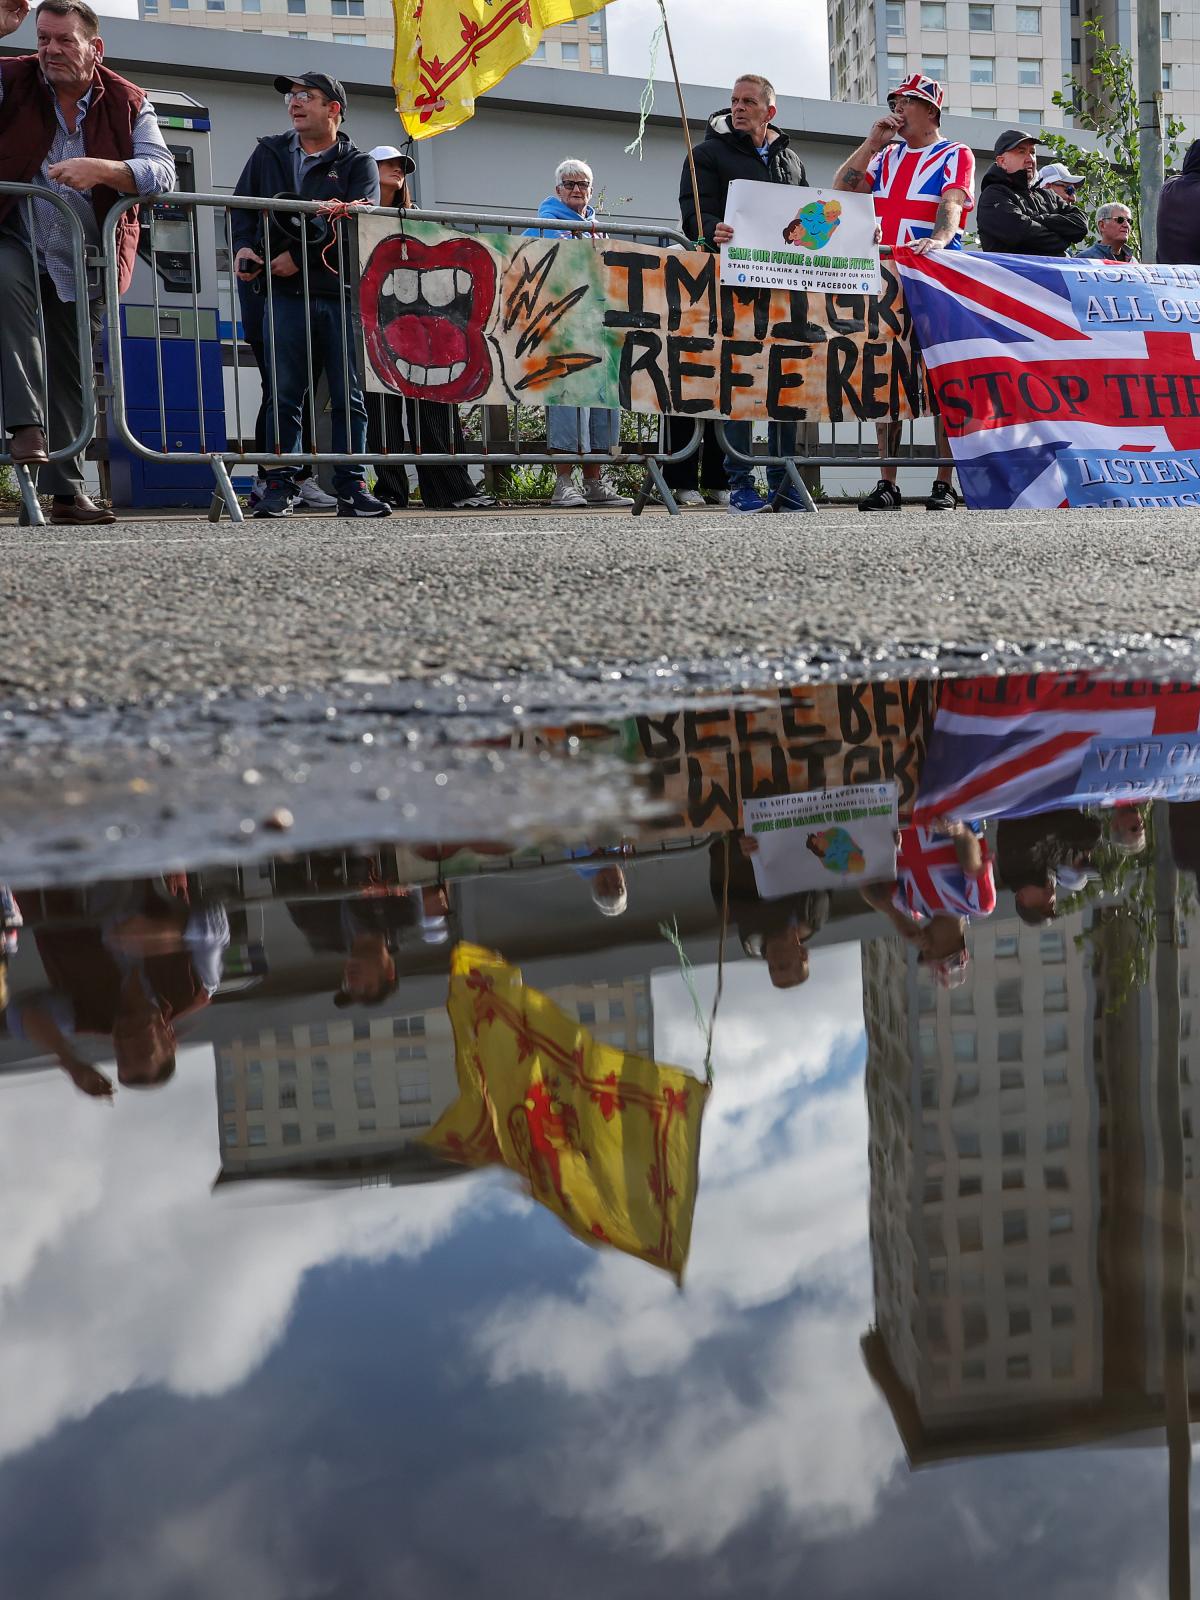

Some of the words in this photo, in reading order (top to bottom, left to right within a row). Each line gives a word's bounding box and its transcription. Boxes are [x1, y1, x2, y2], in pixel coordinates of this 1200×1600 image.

[727, 247, 752, 261] SAVE
[752, 249, 770, 263] OUR
[771, 251, 804, 266] FUTURE
[805, 255, 812, 267] &
[813, 255, 831, 268] OUR
[832, 256, 849, 269] KIDS
[849, 257, 875, 270] FUTURE
[750, 275, 783, 284] FOLLOW
[816, 281, 858, 290] FACEBOOK
[1086, 295, 1155, 324] ALL
[939, 372, 1090, 429] STOP
[1074, 457, 1200, 487] LISTEN
